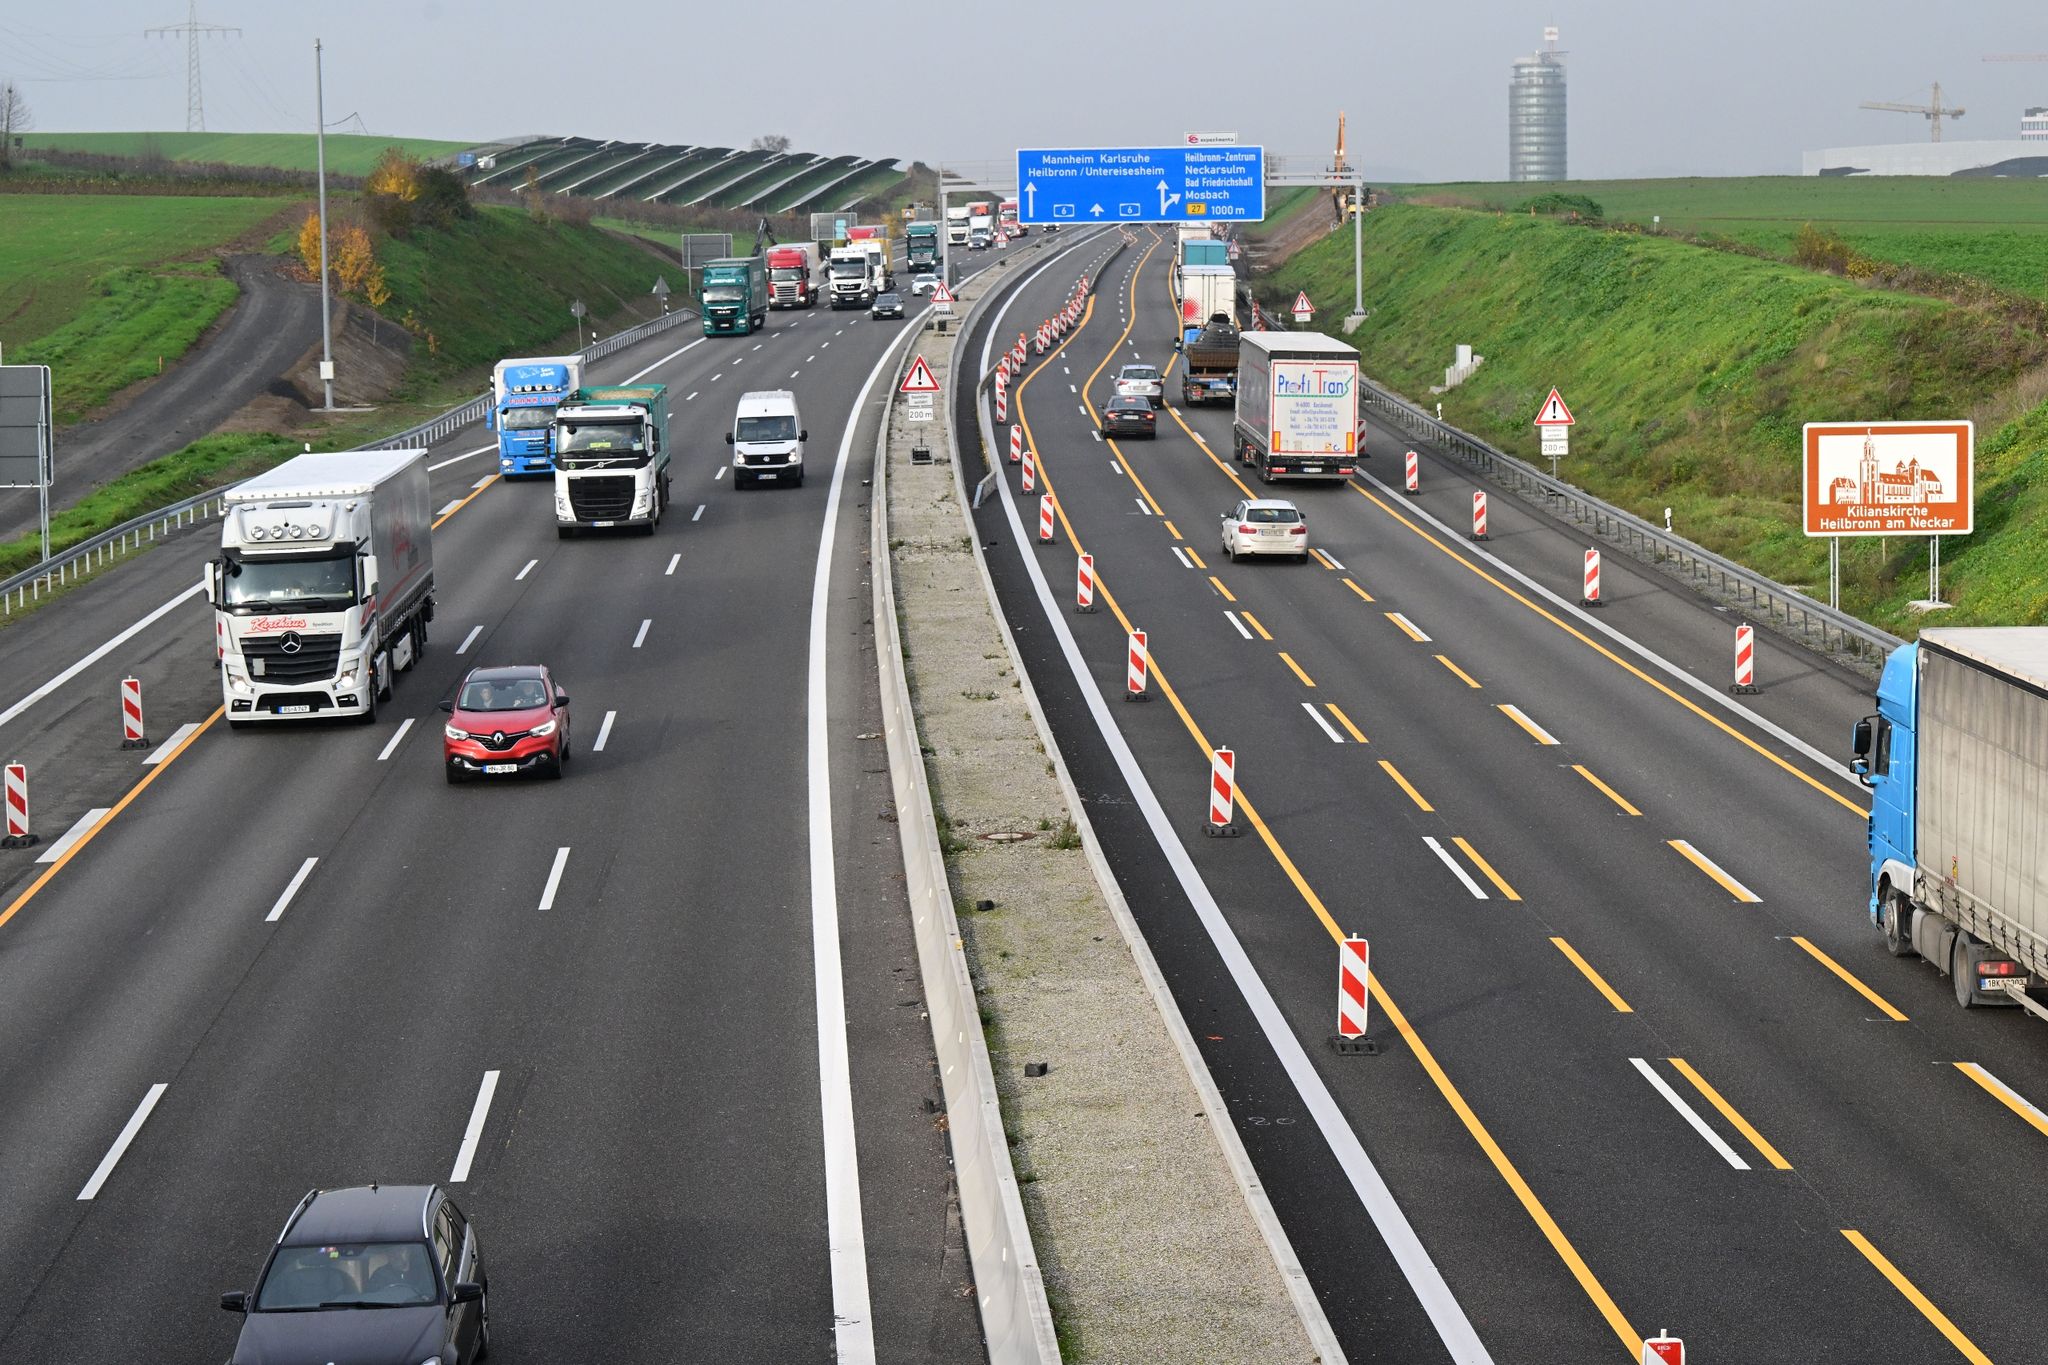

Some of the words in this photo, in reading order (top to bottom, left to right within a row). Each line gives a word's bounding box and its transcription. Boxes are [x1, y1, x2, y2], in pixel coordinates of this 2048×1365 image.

[1042, 154, 1094, 165] Mannheim
[1100, 153, 1150, 164] Karlsruhe
[1185, 152, 1256, 162] Heilbronn-Zentrum
[1028, 167, 1077, 177] Heilbronn
[1185, 165, 1246, 175] Neckarsulm
[1185, 177, 1199, 187] Bad
[1202, 177, 1253, 187] Friedrichshall
[1185, 190, 1229, 200] Mosbach
[1061, 207, 1067, 215] 6
[1127, 206, 1133, 214] 6
[1191, 205, 1201, 213] 27
[1211, 206, 1233, 215] 1000
[1235, 207, 1245, 215] m
[1847, 505, 1928, 518] Kilianskirche
[1820, 518, 1880, 530] Heilbronn
[1886, 519, 1905, 529] am
[1910, 517, 1955, 529] Neckar
[252, 616, 306, 631] Karthaus
